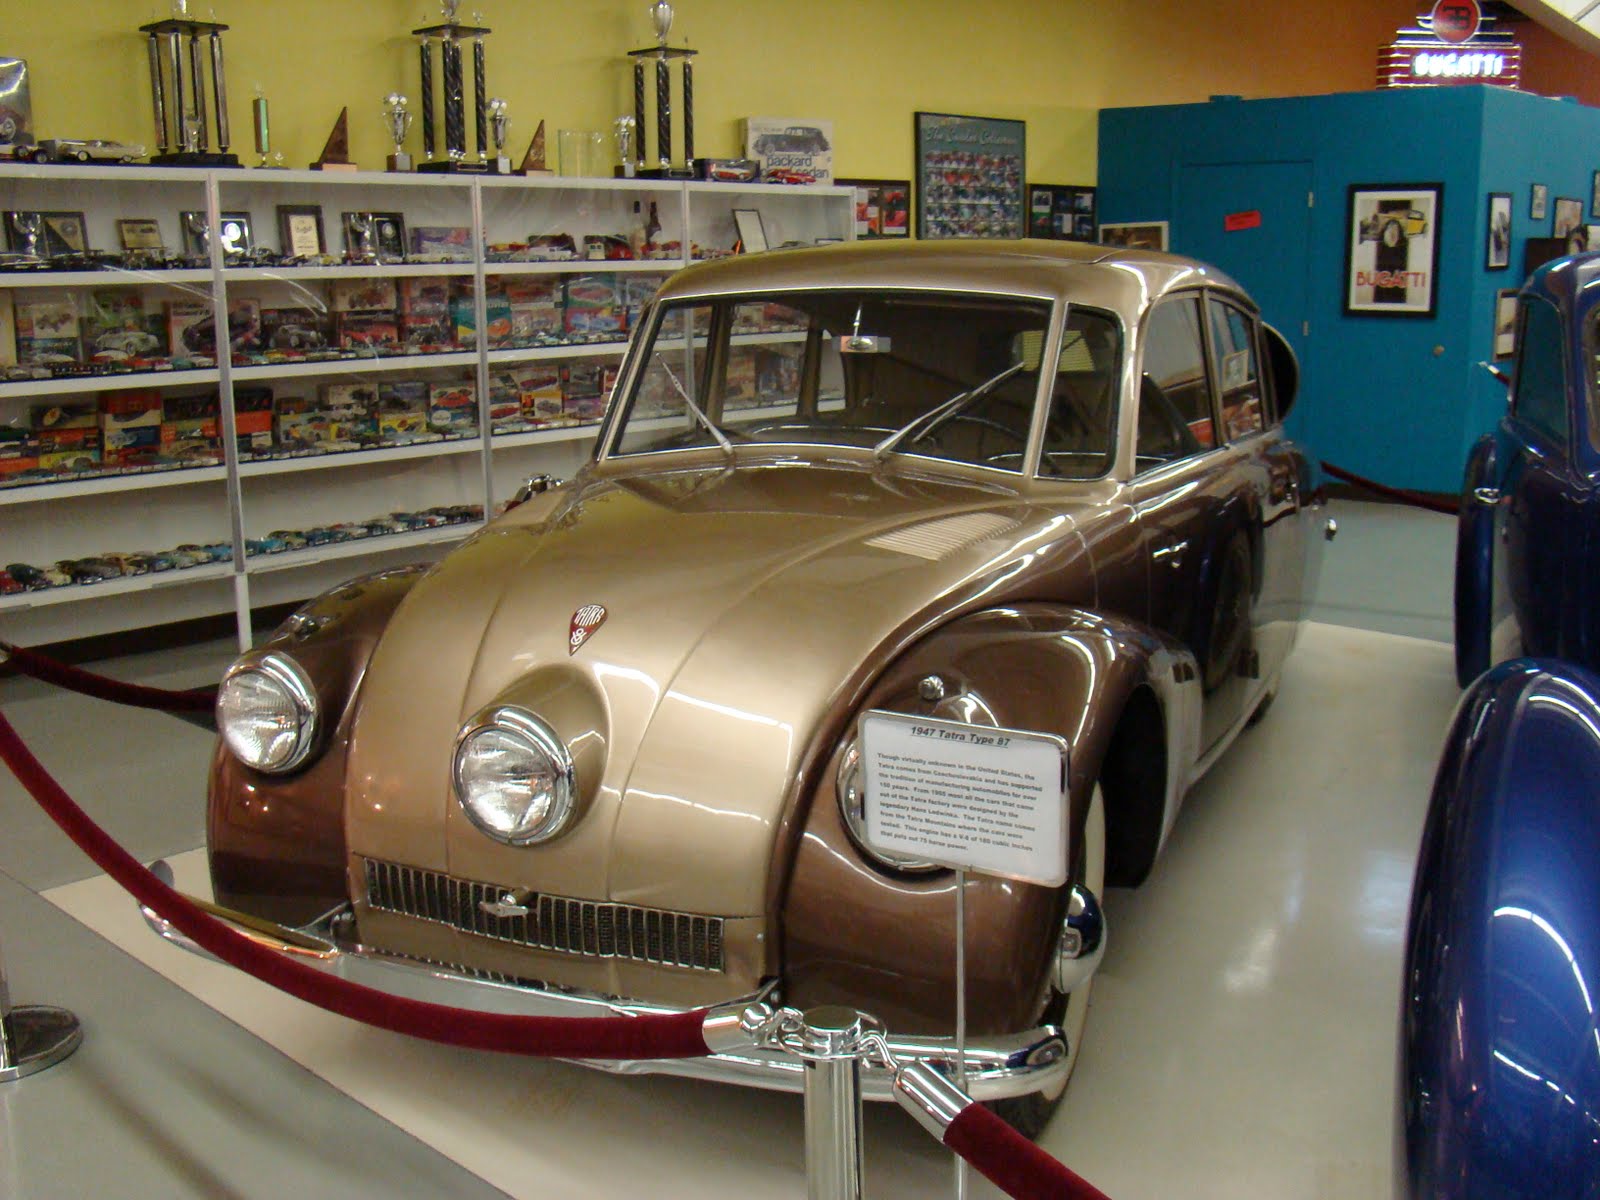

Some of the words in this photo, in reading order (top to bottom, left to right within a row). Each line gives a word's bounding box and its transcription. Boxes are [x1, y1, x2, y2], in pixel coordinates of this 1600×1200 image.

[1413, 53, 1504, 77] BUGATTI
[766, 155, 812, 168] packard
[1356, 270, 1426, 289] BUGATTI
[573, 604, 606, 626] TATRA
[911, 726, 936, 737] 1947
[939, 729, 966, 742] Tatra
[970, 733, 994, 745] Type
[997, 737, 1011, 746] 87
[877, 753, 900, 761] Though
[901, 756, 926, 764] virtually
[924, 779, 970, 791] manufacturing
[971, 786, 1011, 796] automobiles
[1010, 782, 1043, 791] supported
[879, 801, 909, 811] legendary
[927, 799, 950, 807] factory
[968, 805, 997, 814] designed
[924, 818, 956, 827] Mountains
[917, 827, 939, 835] engine
[991, 839, 1009, 847] cubic
